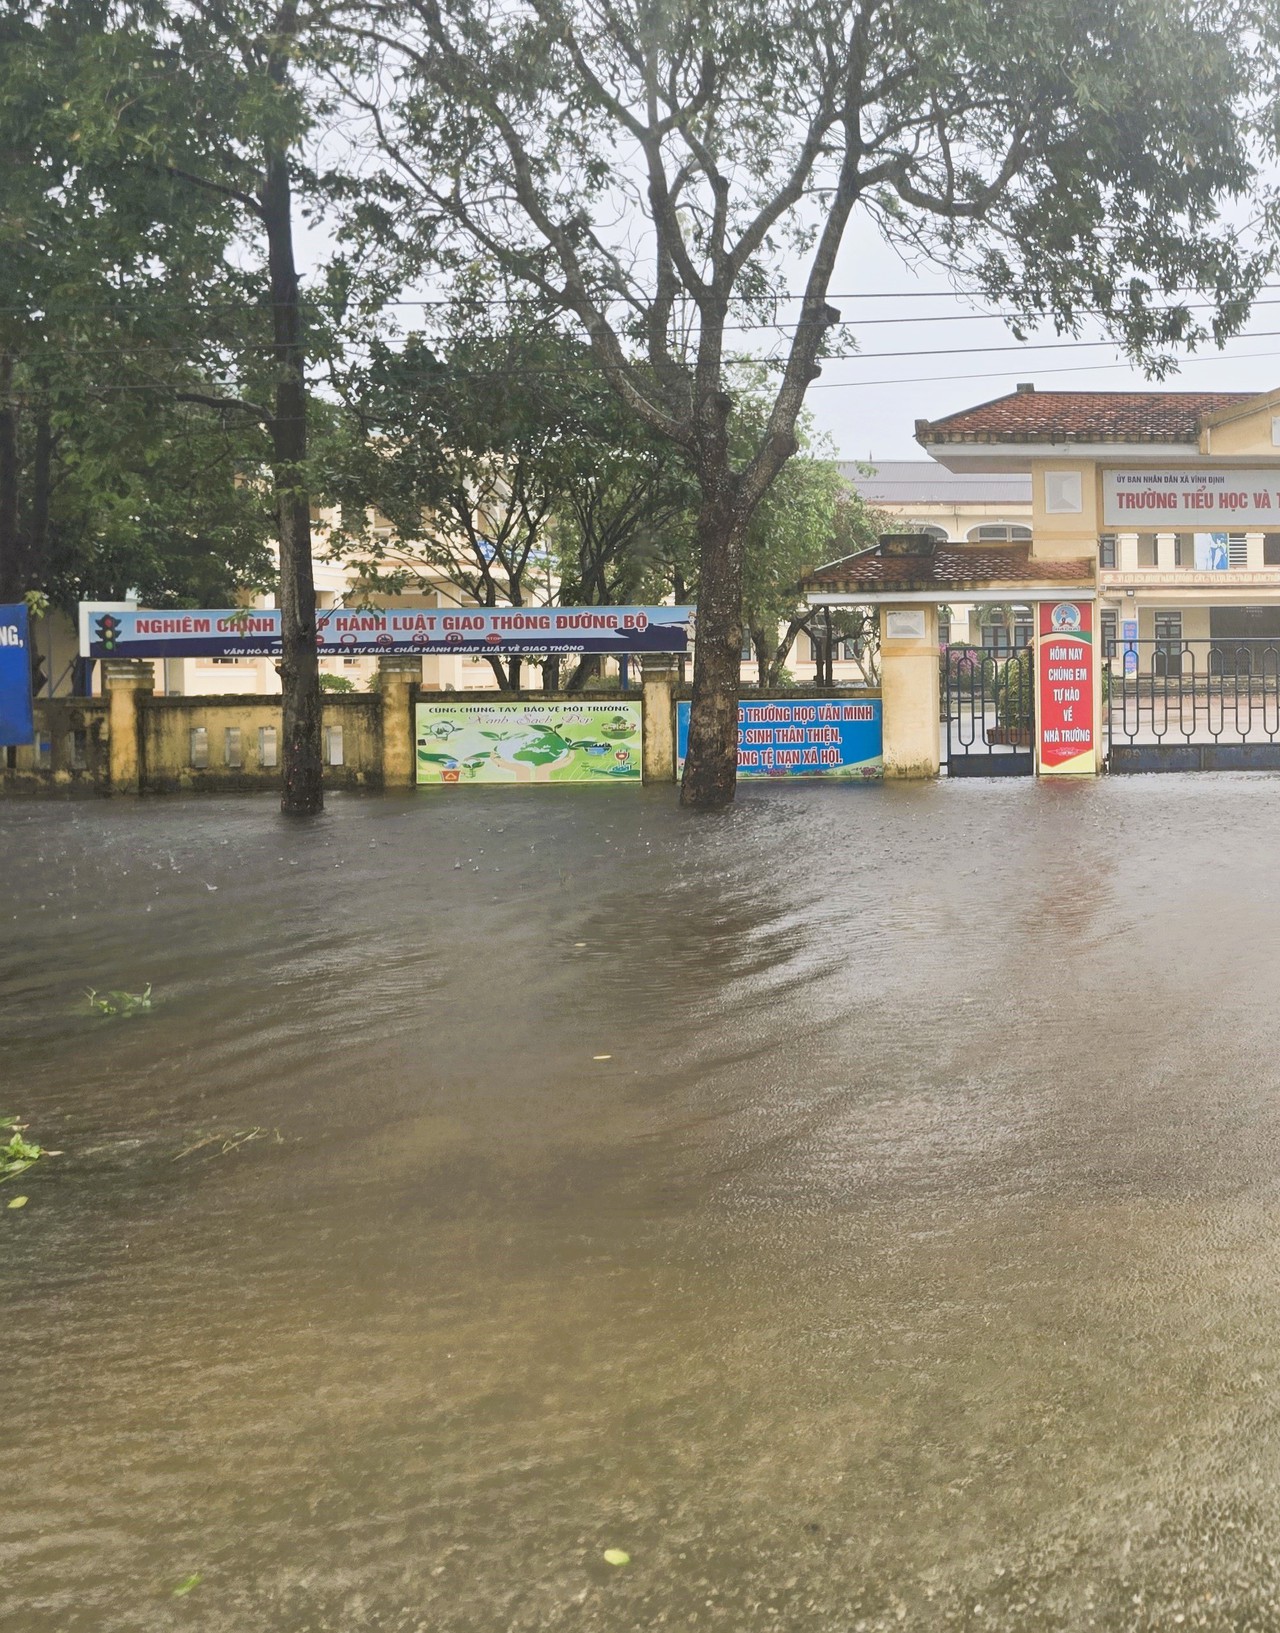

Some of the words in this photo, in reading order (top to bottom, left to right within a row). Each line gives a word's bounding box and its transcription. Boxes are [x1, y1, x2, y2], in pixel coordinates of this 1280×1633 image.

[1116, 473, 1126, 484] ỦY
[1127, 476, 1142, 484] BAN
[1143, 474, 1163, 484] NHÂN
[1164, 474, 1179, 484] DÂN
[1190, 473, 1207, 483] VĨNH
[1116, 487, 1178, 509] TRƯỜNG
[1182, 485, 1214, 509] TIỂU
[1218, 492, 1248, 512] HỌC
[1252, 488, 1272, 508] VÀ
[136, 614, 210, 634] NGHIÊM
[336, 615, 387, 631] HÀNH
[392, 614, 436, 633] LUẬT
[442, 616, 484, 631] GIAO
[490, 613, 550, 630] THÔNG
[556, 612, 618, 629] ĐƯỜNG
[624, 612, 648, 631] BỘ
[550, 643, 585, 652] THÔNG
[1049, 645, 1067, 660] HÔM
[1068, 648, 1083, 660] NAY
[1048, 666, 1073, 681] CHÚNG
[1075, 668, 1087, 681] EM
[1053, 688, 1064, 704] TỰ
[1064, 687, 1080, 701] HÀO
[747, 704, 790, 722] TRƯỜNG
[793, 706, 815, 724] HỌC
[818, 703, 841, 721] VĂN
[843, 705, 873, 720] MINH
[746, 728, 773, 743] SINH
[775, 726, 805, 743] THÂN
[807, 725, 842, 745] THIỆN,
[1044, 727, 1060, 743] NHÀ
[1061, 727, 1091, 742] TRƯỜNG
[760, 748, 774, 766] TỆ
[777, 751, 799, 767] NẠN
[803, 747, 818, 763] XÃ
[821, 749, 843, 766] HỘI.
